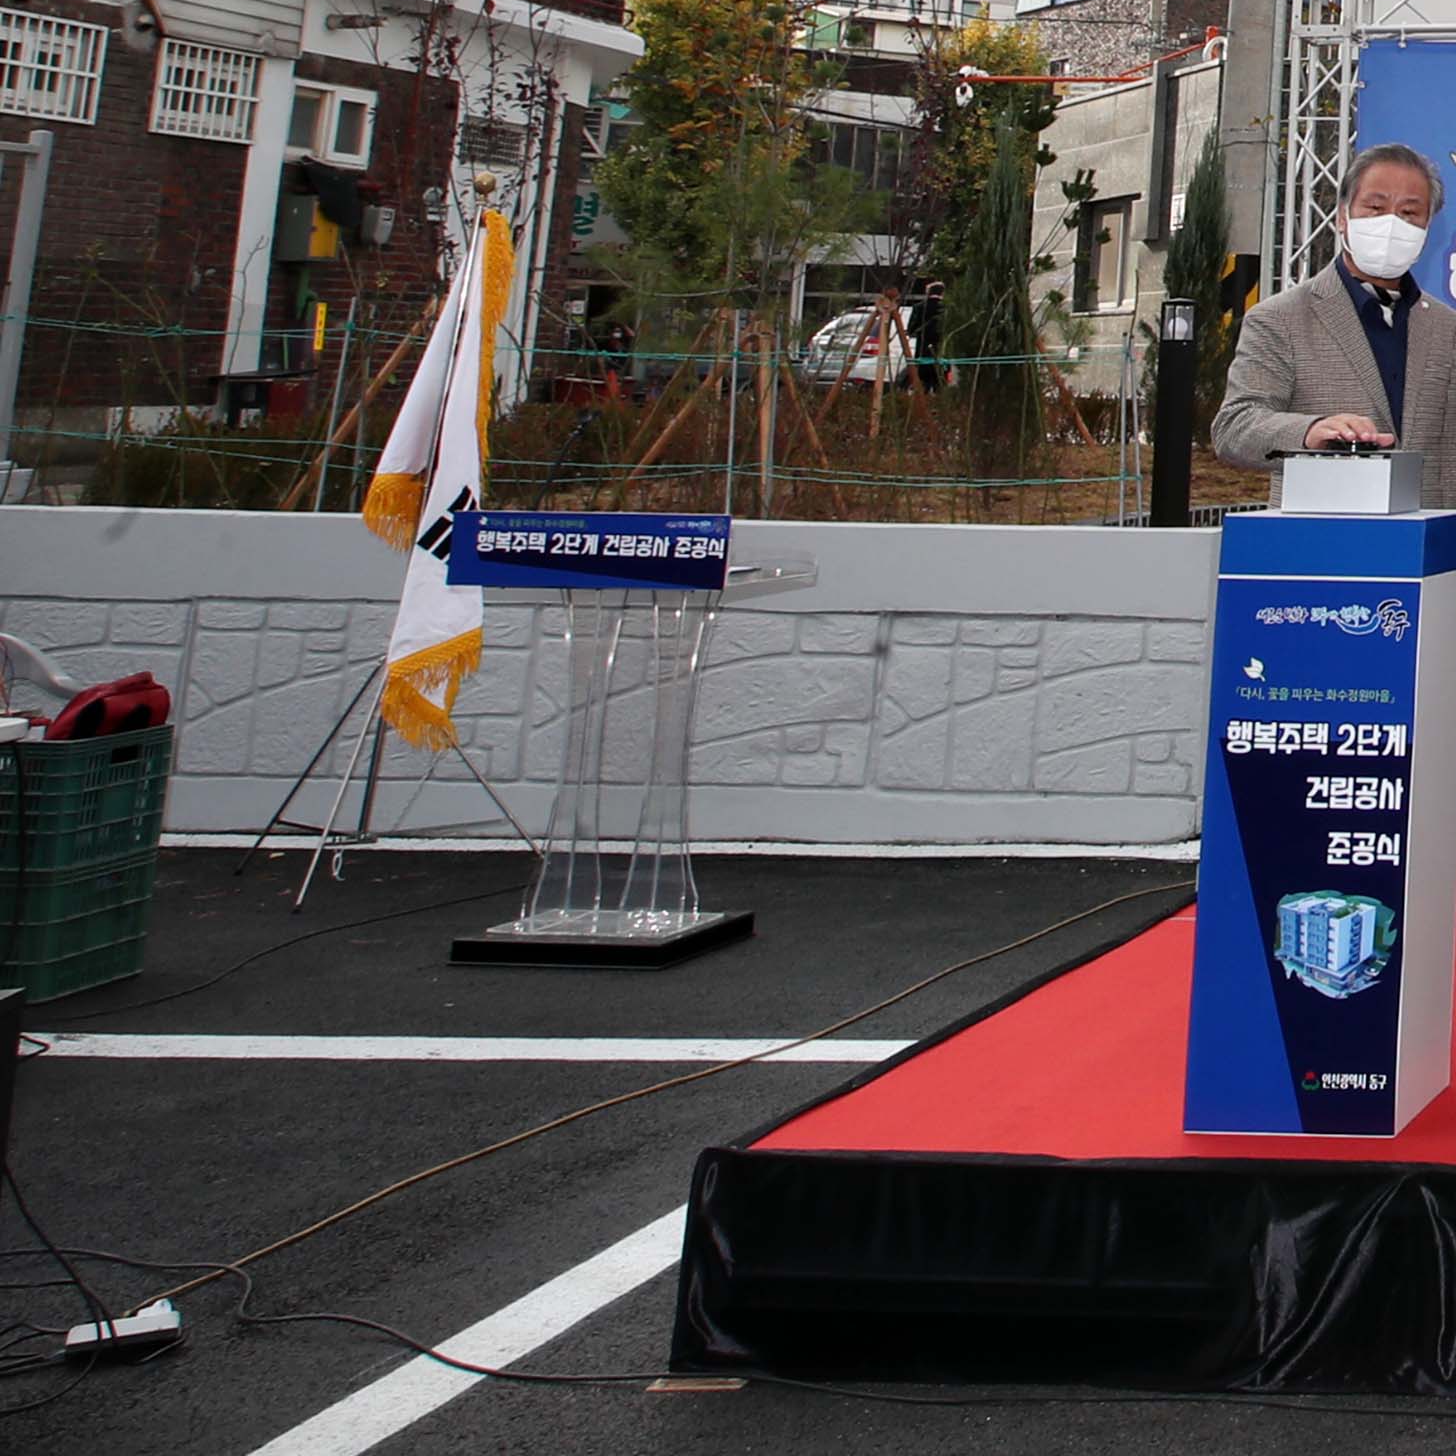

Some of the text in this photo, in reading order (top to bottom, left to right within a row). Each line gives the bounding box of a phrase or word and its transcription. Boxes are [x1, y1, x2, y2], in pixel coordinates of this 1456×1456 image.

[476, 530, 725, 559] 행복주택 2단계 건립공사 준공식
[1227, 720, 1407, 757] 행복주택 2단계
[1305, 776, 1404, 810] 건립공사
[1326, 831, 1400, 866] 준공식
